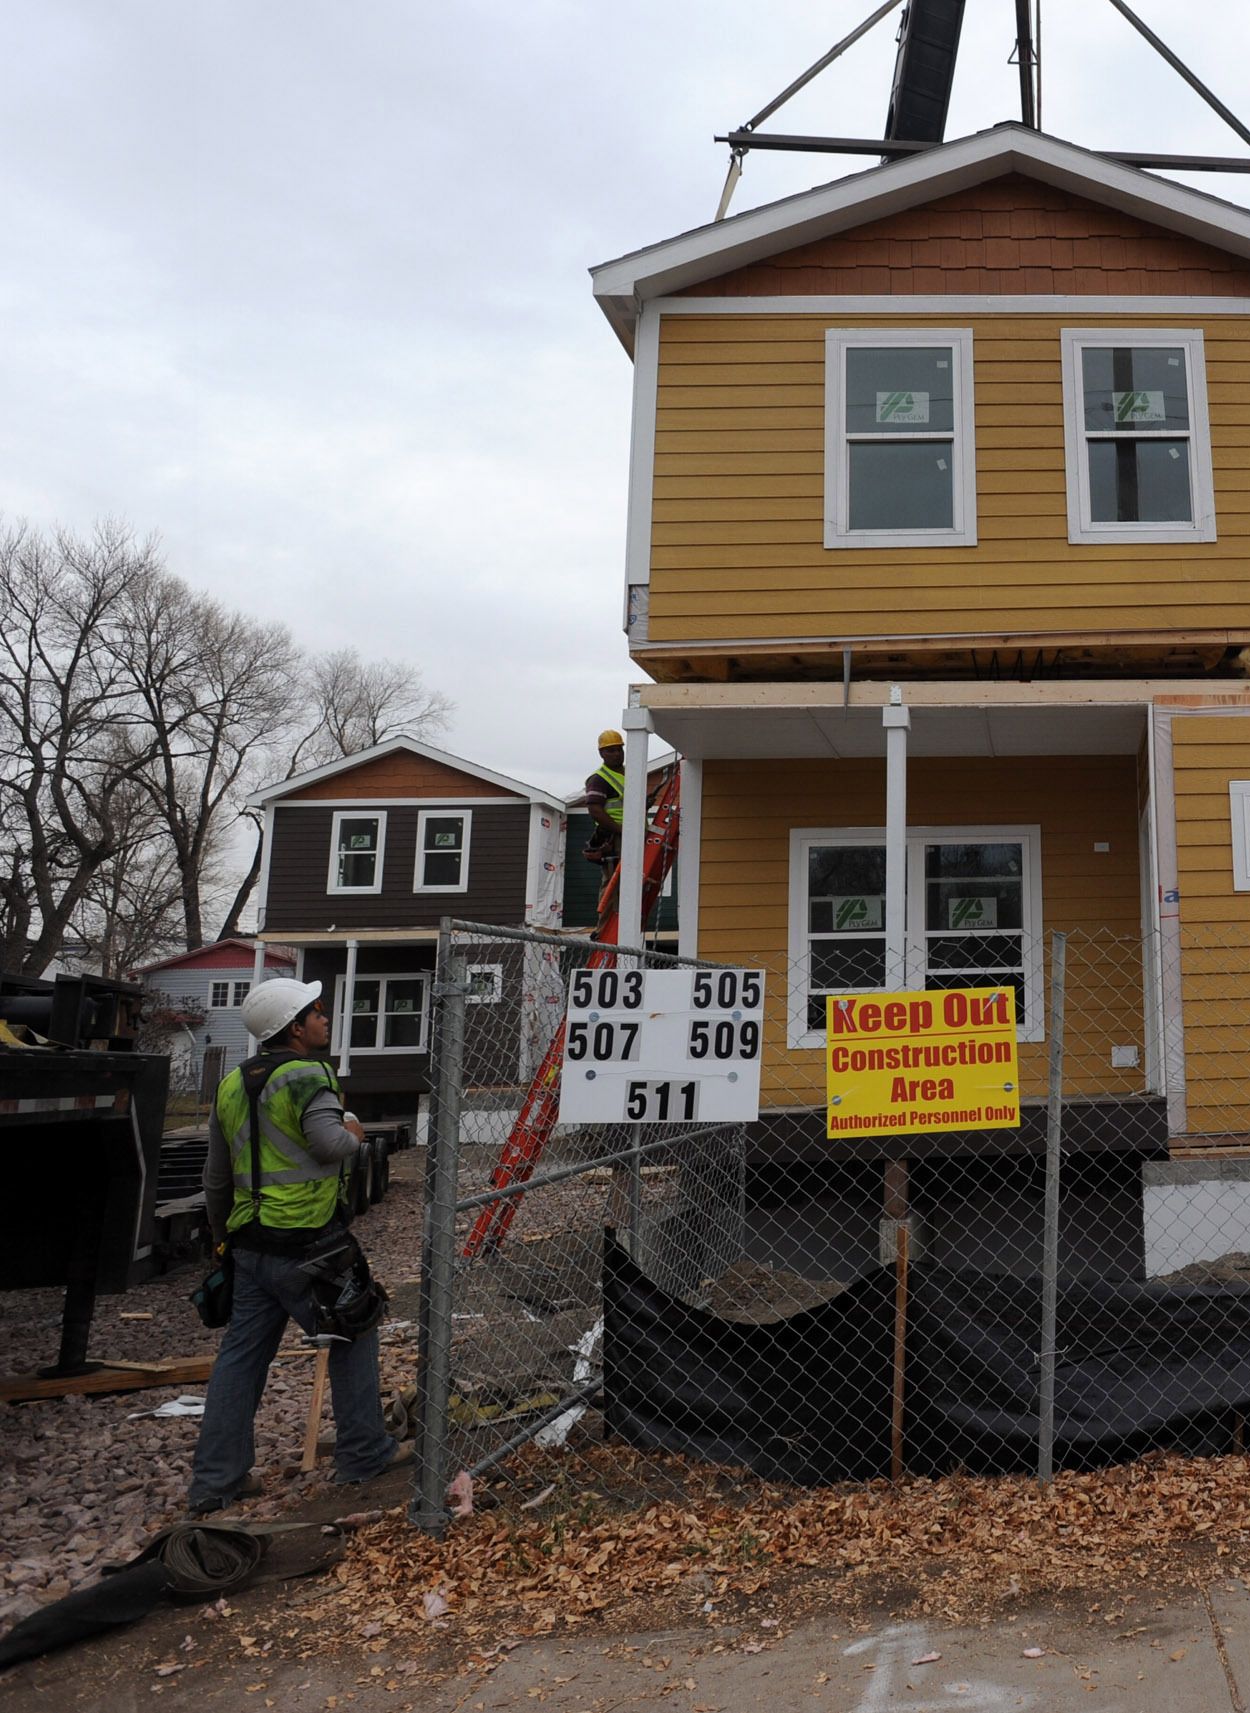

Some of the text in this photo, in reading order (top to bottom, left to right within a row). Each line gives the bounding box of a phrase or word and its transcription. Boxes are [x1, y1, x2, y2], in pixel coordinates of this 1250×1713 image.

[573, 971, 760, 1009] 503 505
[833, 992, 1010, 1034] Keep Out
[568, 1021, 759, 1061] 507 509
[832, 1040, 1012, 1073] Construction
[627, 1081, 696, 1121] 511
[891, 1077, 955, 1103] Area
[830, 1105, 1016, 1131] Authorized Personnel Only
